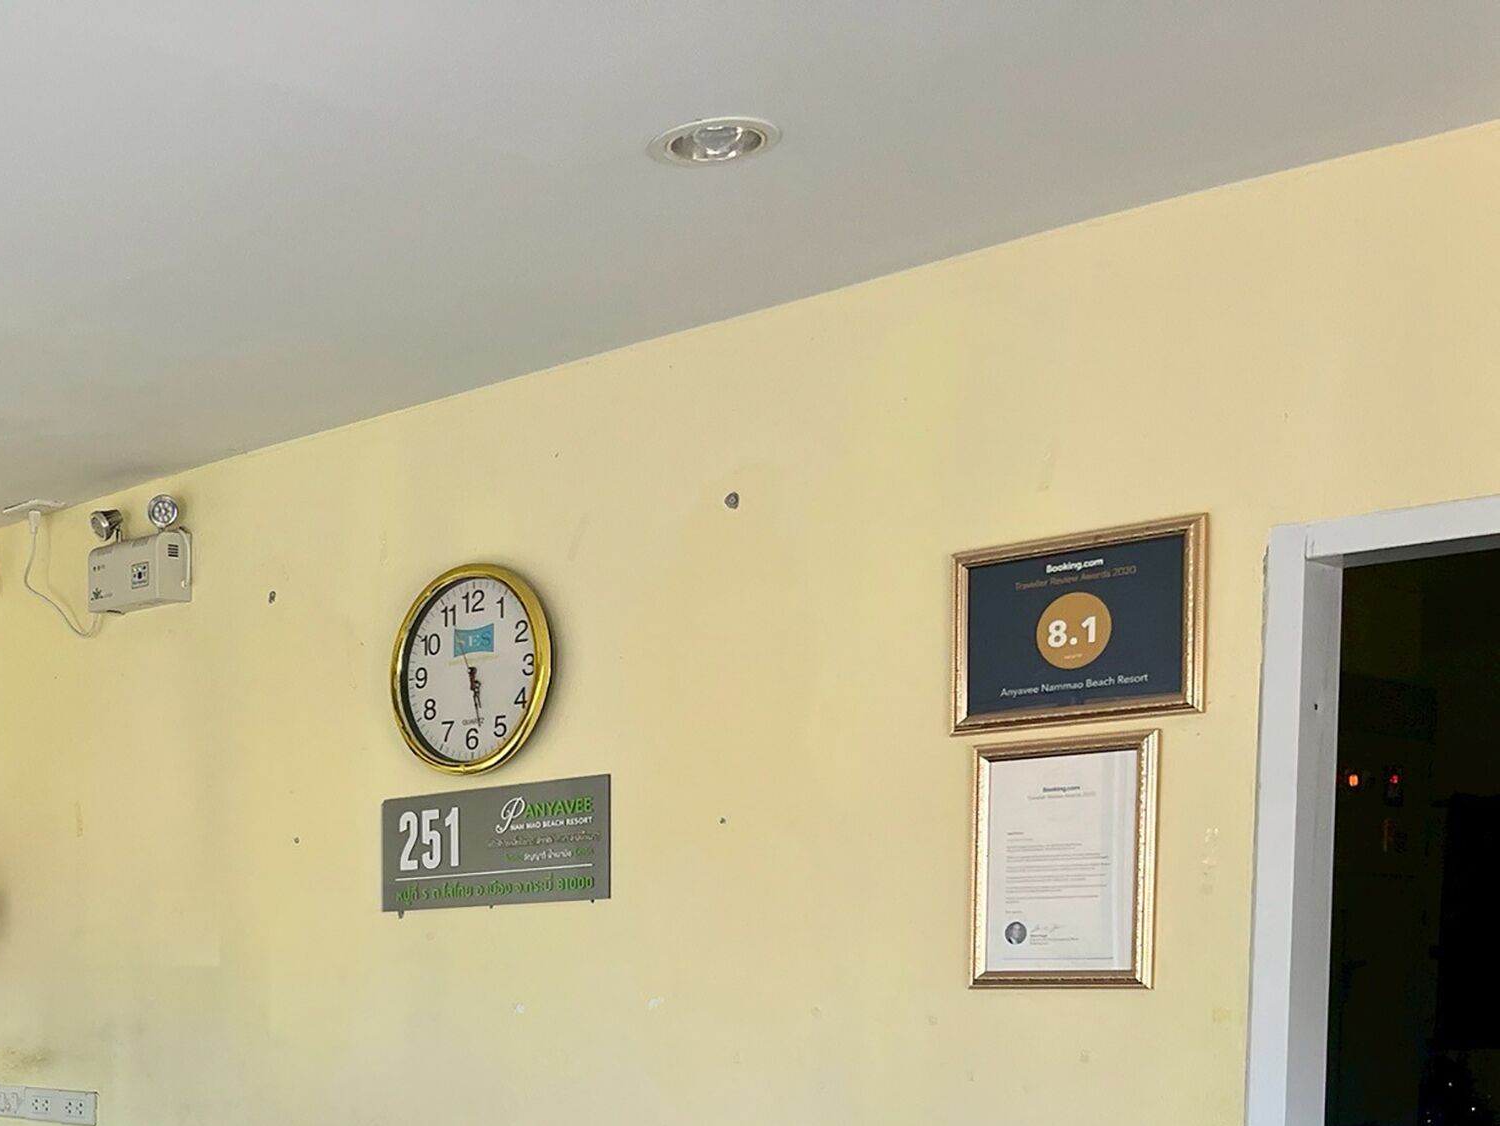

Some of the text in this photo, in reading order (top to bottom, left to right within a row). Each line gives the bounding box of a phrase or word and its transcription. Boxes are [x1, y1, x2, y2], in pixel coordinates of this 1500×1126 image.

[1045, 558, 1104, 573] Booking.com
[461, 589, 485, 613] 12
[496, 597, 505, 618] 1
[441, 604, 457, 627] 11
[515, 620, 529, 643] 2
[1047, 615, 1097, 648] 8.1
[421, 633, 441, 656] 10
[522, 653, 535, 676] 3
[415, 667, 428, 689] 9
[1000, 673, 1149, 699] Anyavee Nammao Beach Resort
[514, 686, 528, 709] 4
[423, 699, 437, 721] 8
[442, 721, 455, 743] 7
[493, 715, 507, 738] 5
[465, 728, 479, 750] 6
[566, 816, 593, 826] RESORT
[399, 806, 460, 872] 251
[556, 876, 594, 891] 81000
